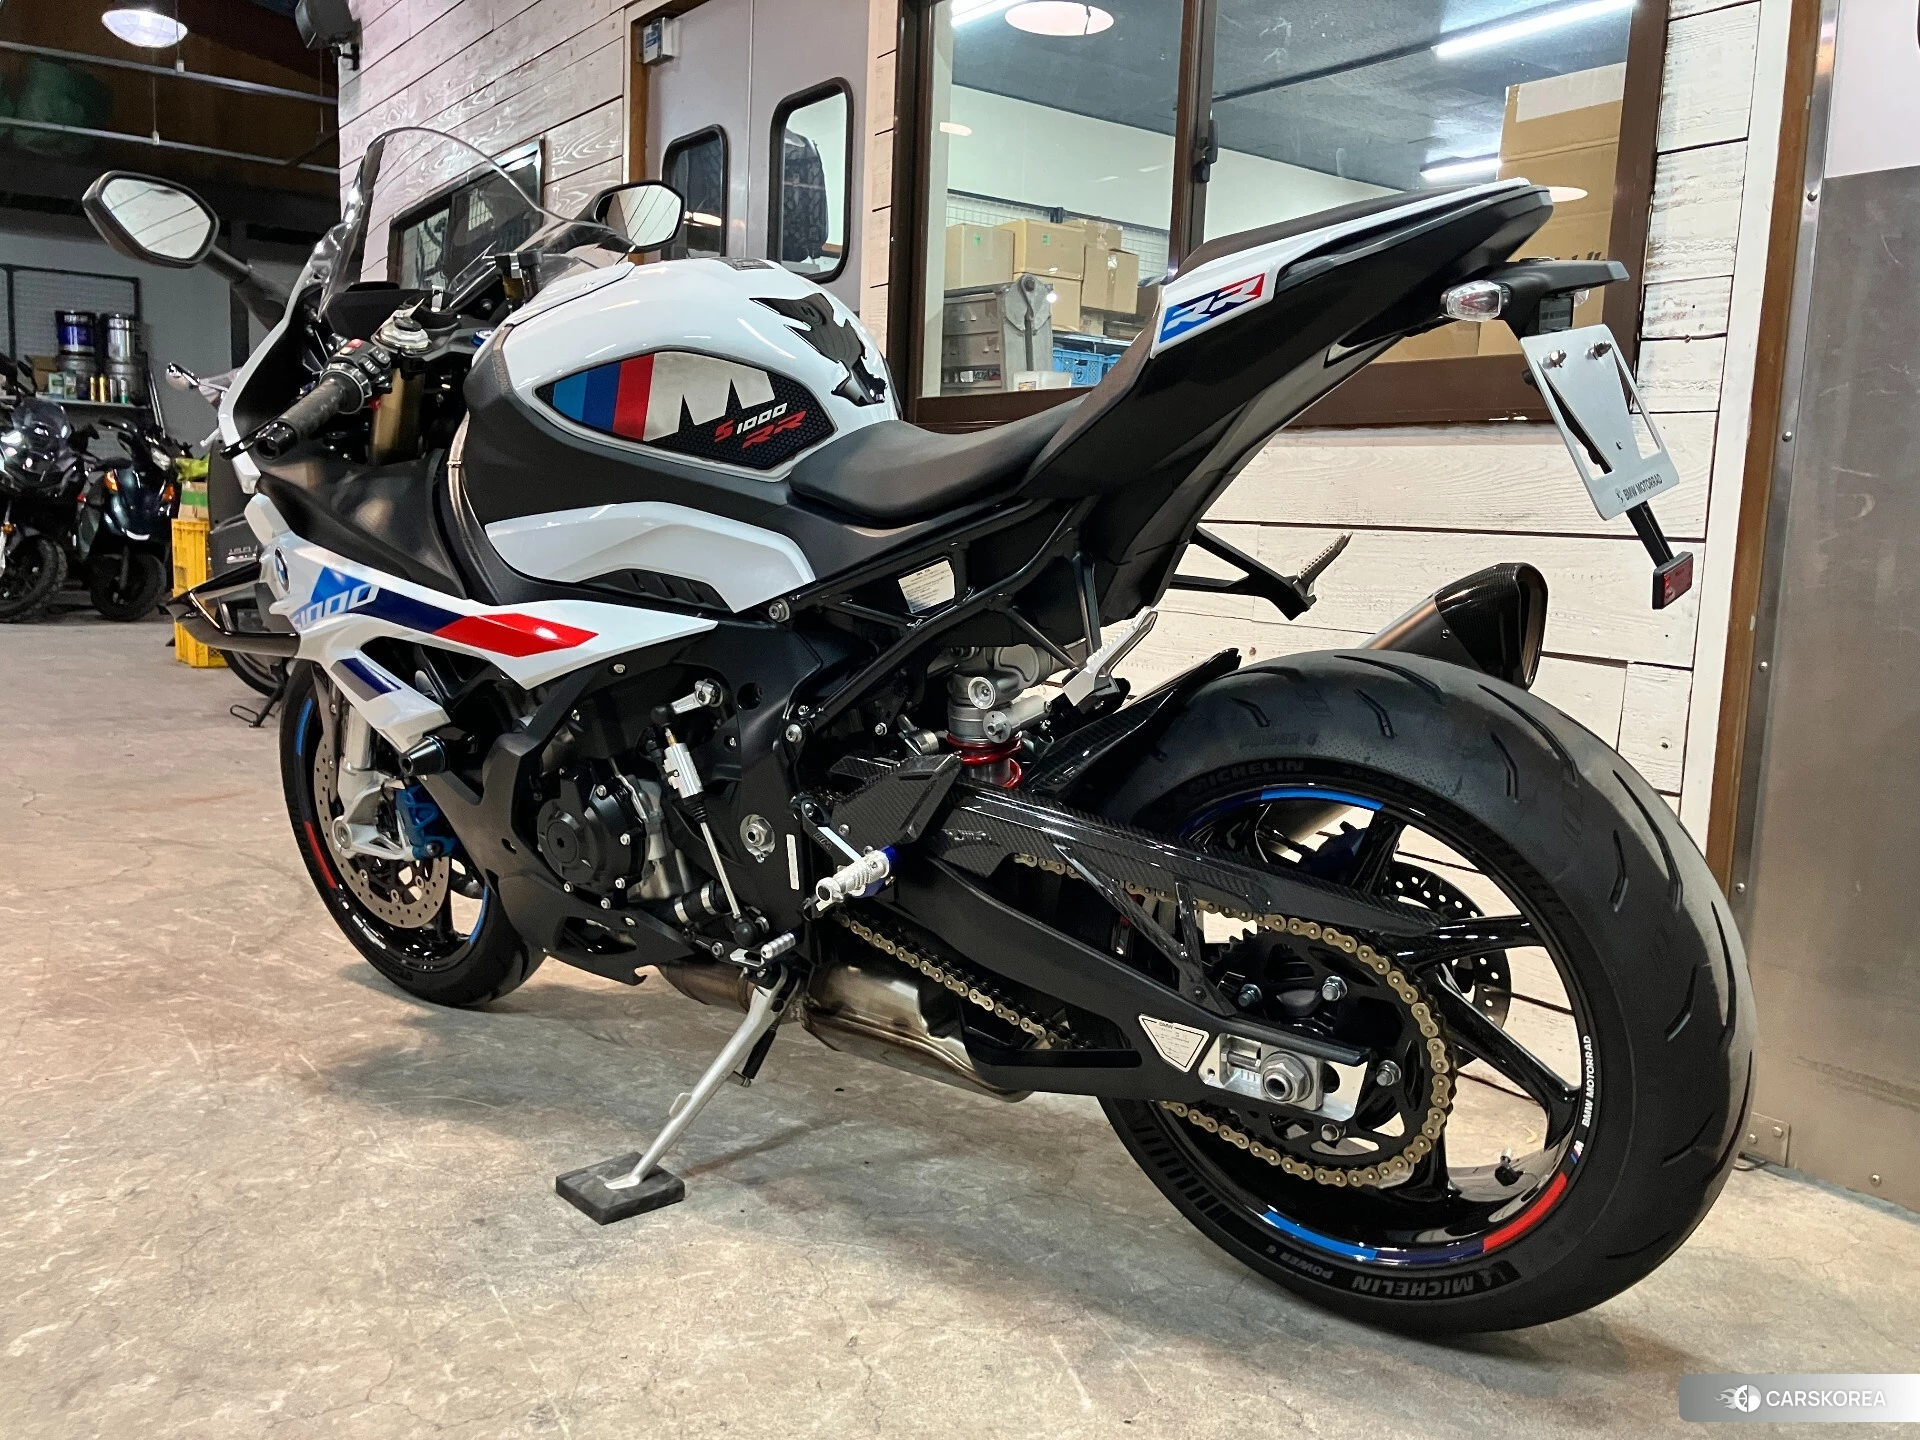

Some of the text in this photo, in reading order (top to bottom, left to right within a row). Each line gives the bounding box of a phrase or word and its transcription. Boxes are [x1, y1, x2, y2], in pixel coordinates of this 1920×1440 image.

[1163, 275, 1262, 333] RR
[643, 351, 776, 442] M
[742, 410, 807, 450] RR
[1622, 483, 1639, 501] BMW
[1583, 1035, 1595, 1098] MOTORRAD
[1581, 1099, 1594, 1128] BMW
[1279, 1251, 1334, 1280] POWER
[1352, 1274, 1474, 1297] MICHELIN
